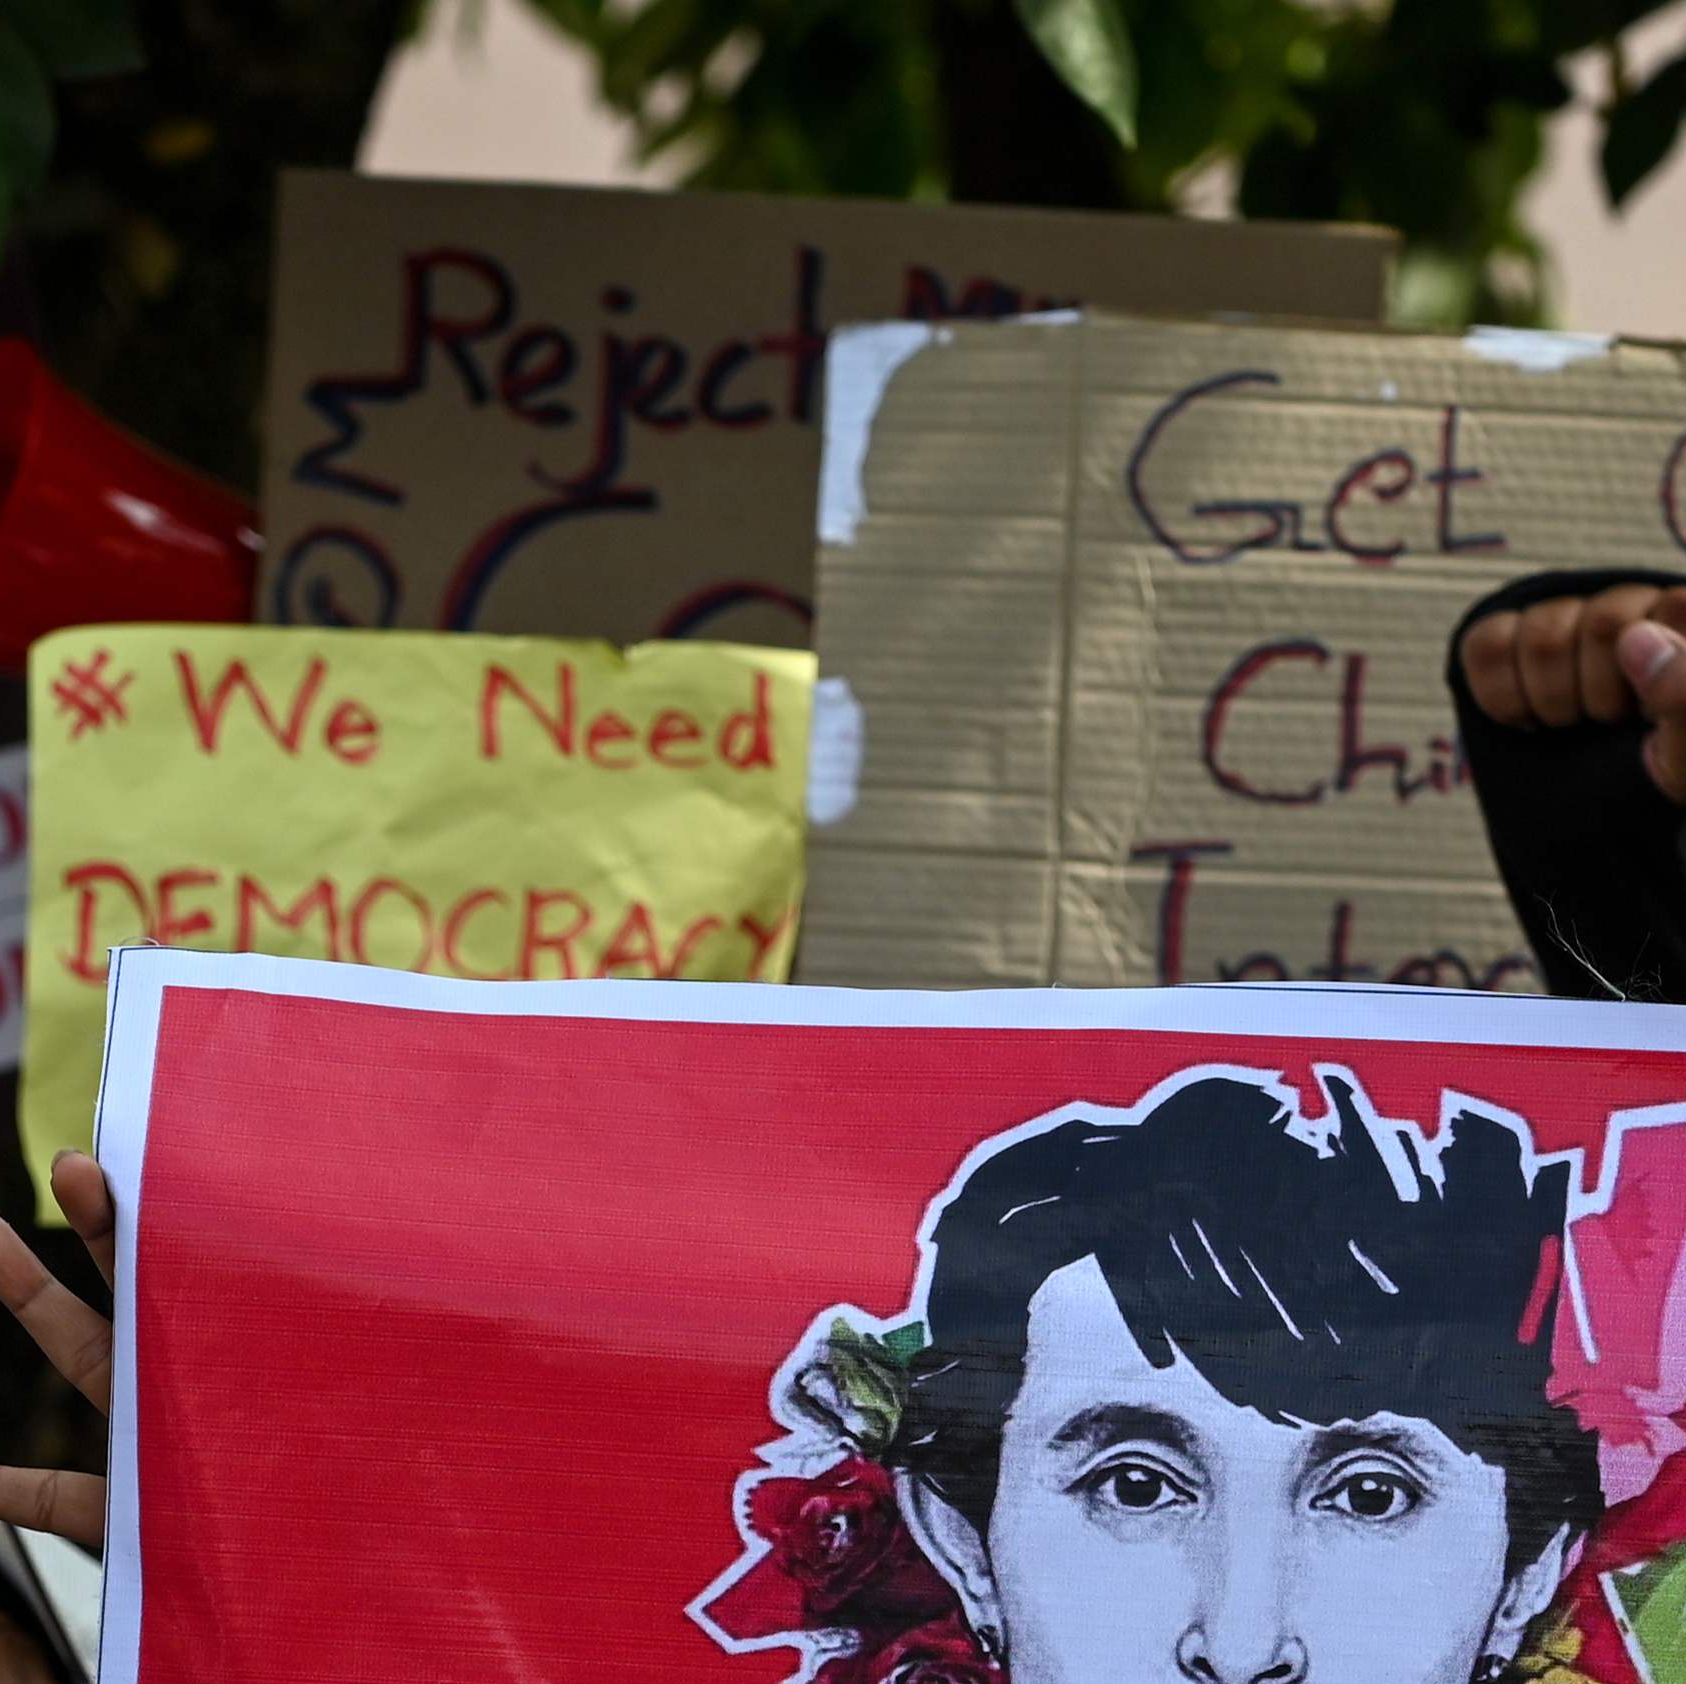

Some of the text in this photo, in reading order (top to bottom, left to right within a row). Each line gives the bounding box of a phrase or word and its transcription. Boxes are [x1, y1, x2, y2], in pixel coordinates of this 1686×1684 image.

[398, 245, 828, 498] Reject
[1127, 371, 1508, 565] Get
[174, 649, 381, 766] We
[477, 660, 777, 772] Need
